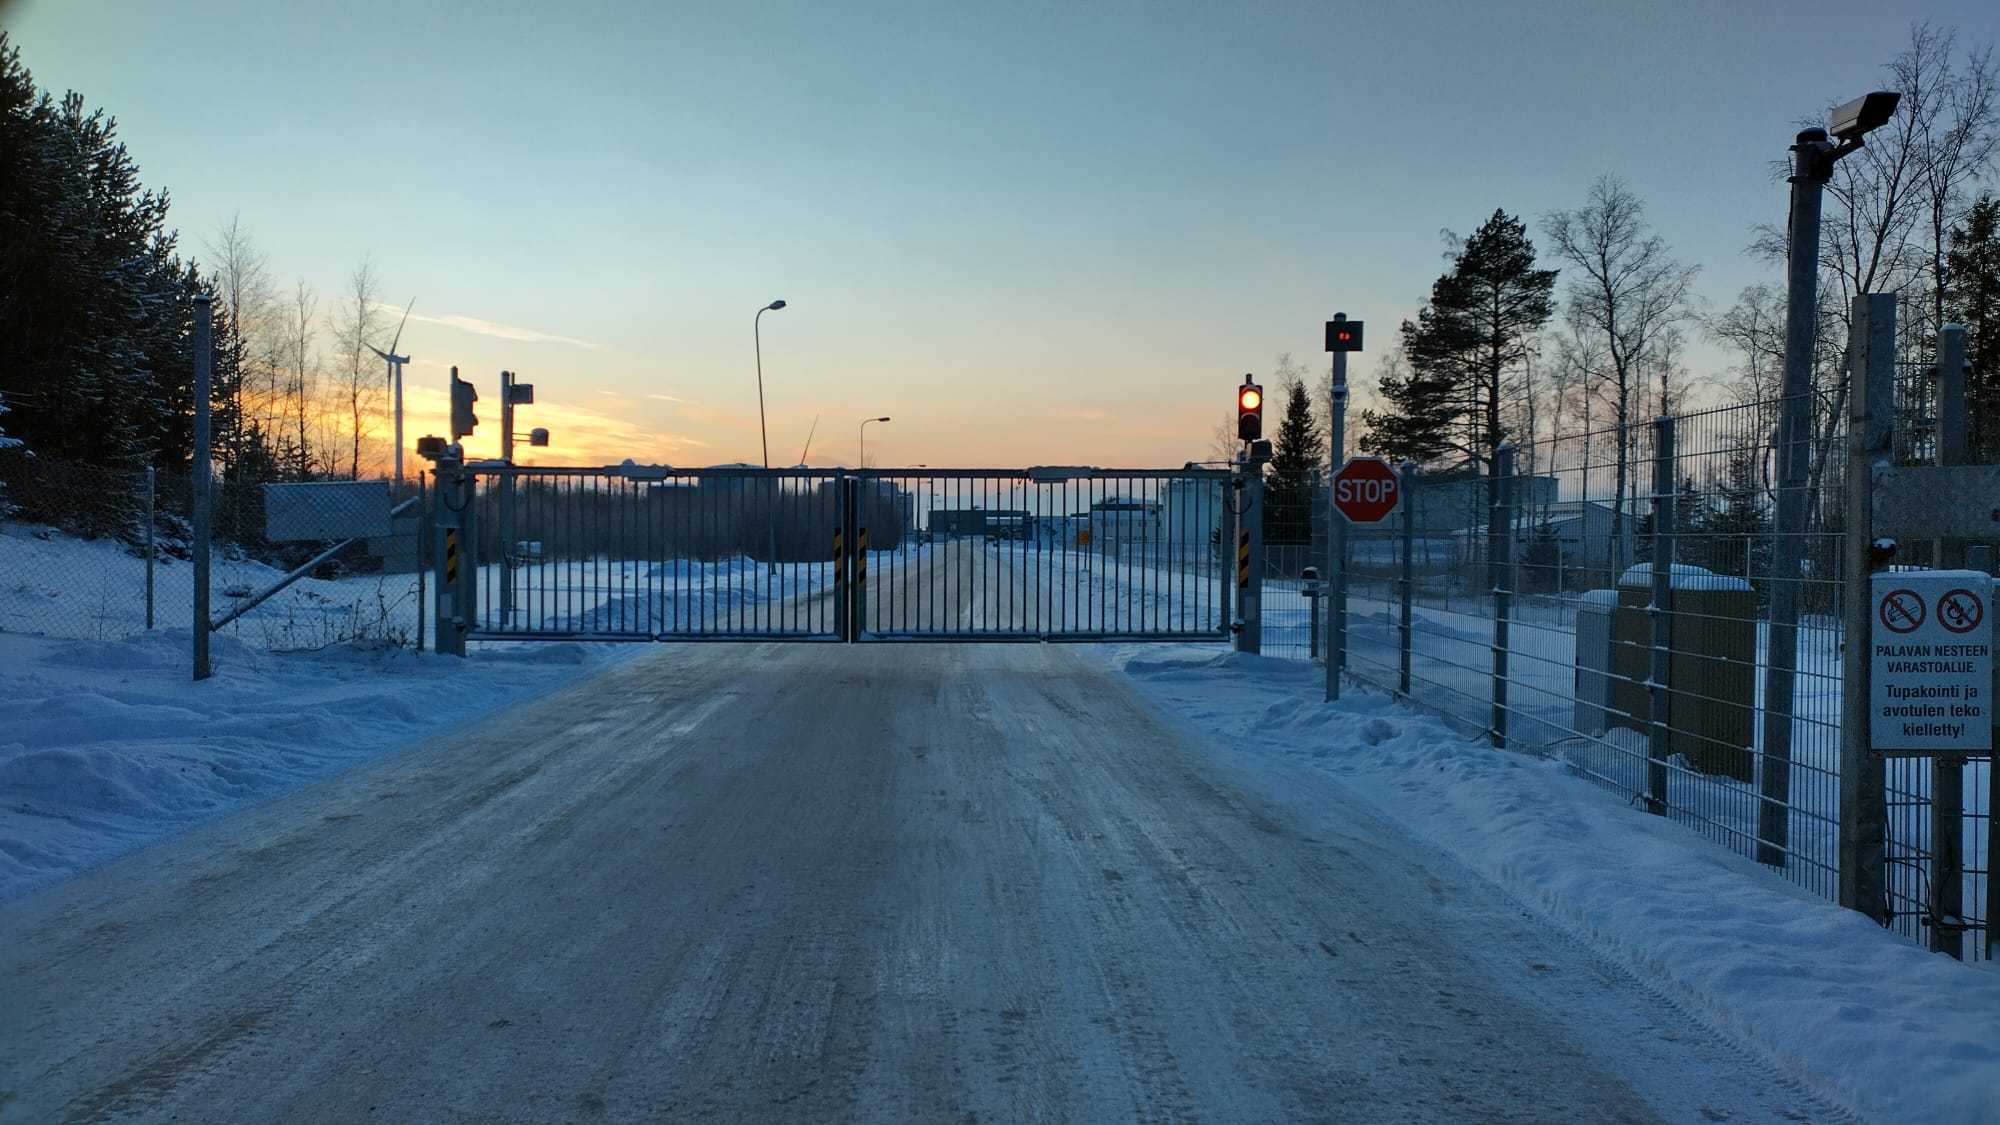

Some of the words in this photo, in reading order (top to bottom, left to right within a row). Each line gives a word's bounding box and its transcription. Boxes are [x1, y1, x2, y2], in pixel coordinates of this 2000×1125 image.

[1338, 479, 1395, 503] STOP
[1876, 645, 1931, 657] PALAVAN
[1934, 645, 1988, 657] NESTEEN
[1887, 661, 1977, 673] VARASTOALUE.
[1885, 684, 1959, 700] Tupakointi
[1964, 684, 1978, 700] ja
[1883, 704, 1945, 717] avotulen
[1950, 704, 1981, 717] teko
[1903, 724, 1965, 739] kielletty!
